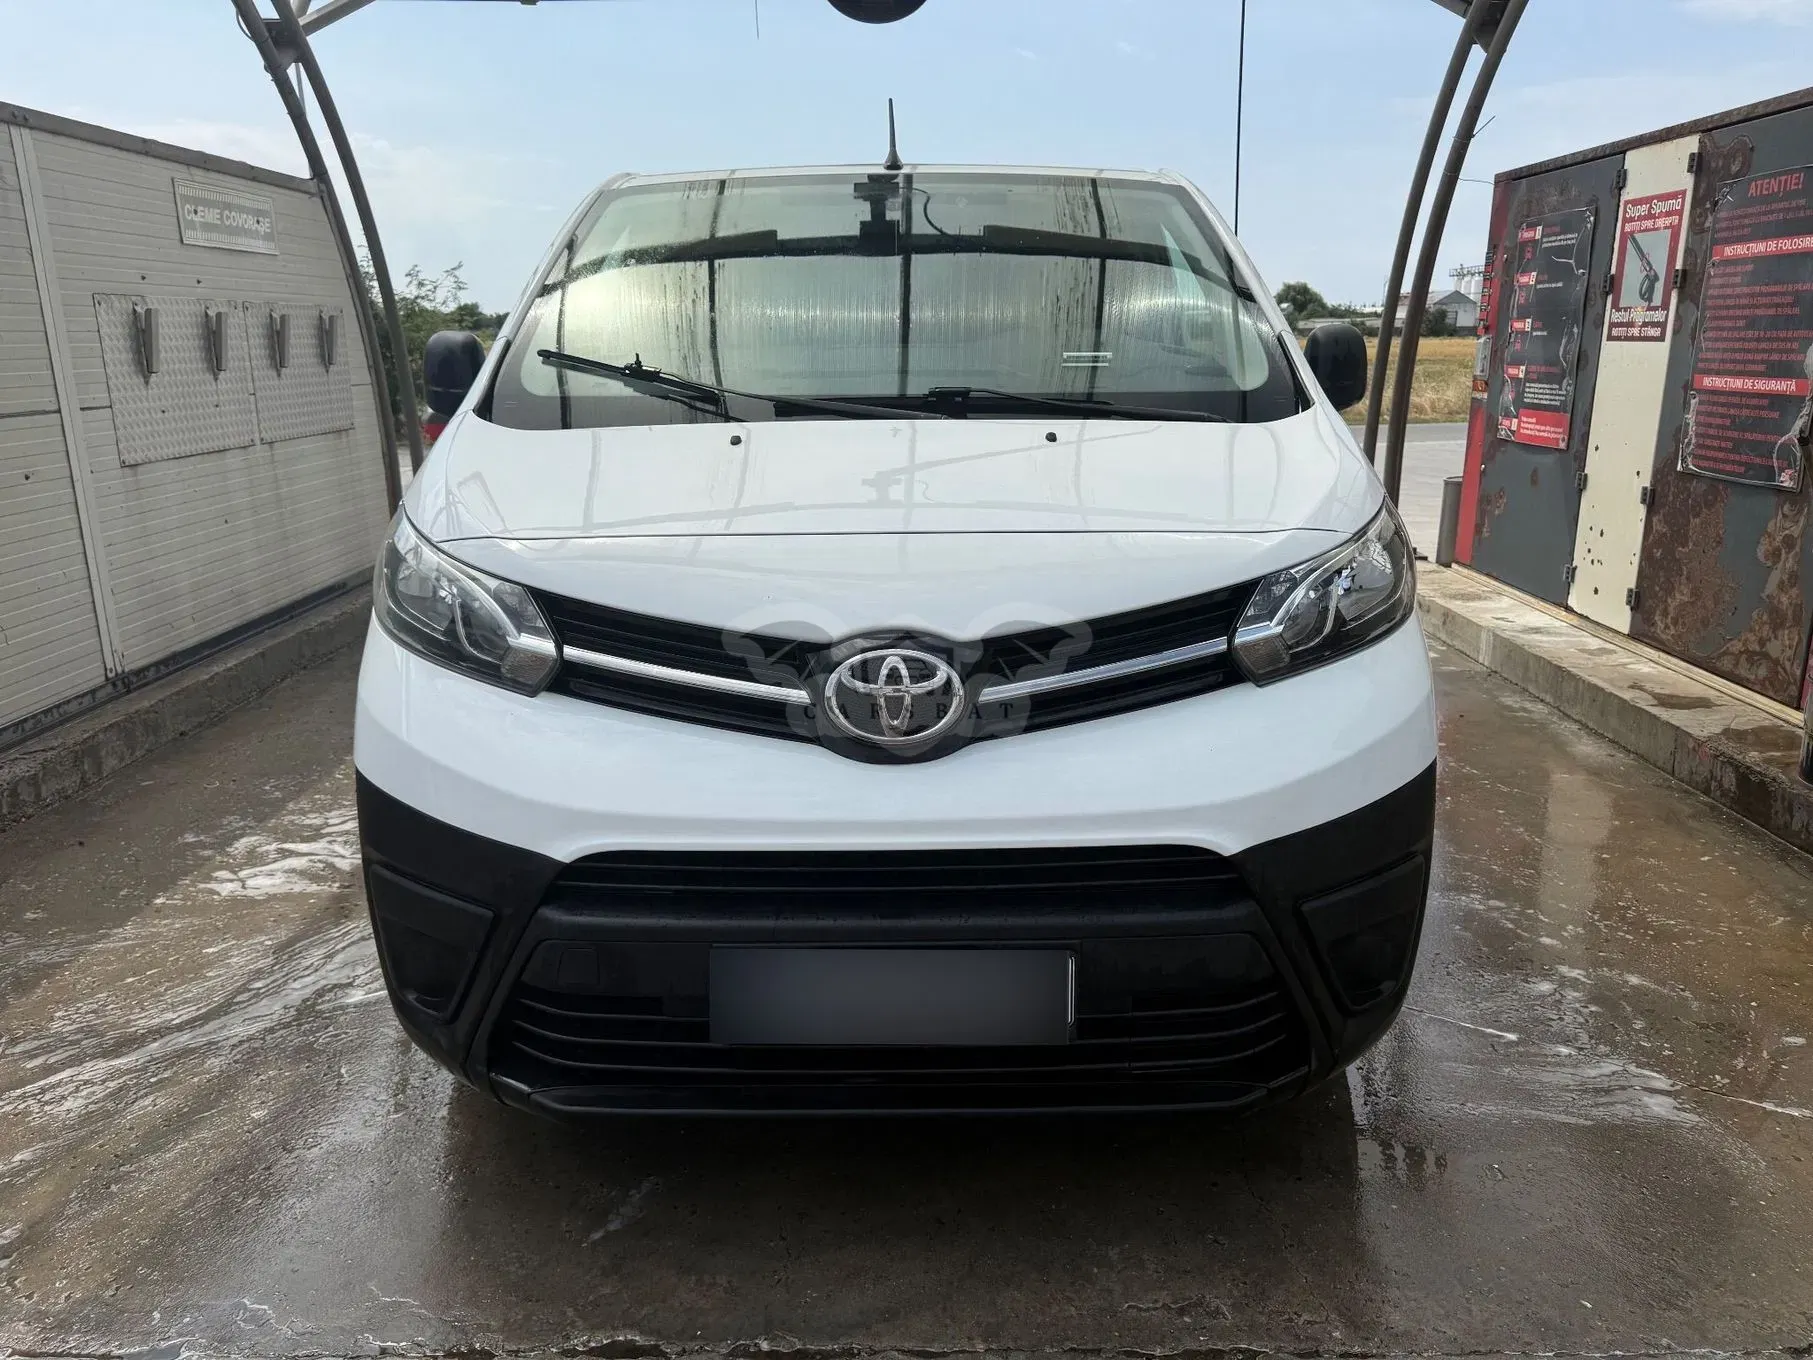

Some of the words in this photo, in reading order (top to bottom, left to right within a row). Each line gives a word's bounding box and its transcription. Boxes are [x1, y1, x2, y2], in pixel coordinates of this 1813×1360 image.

[1748, 173, 1804, 197] ATENȚIE!
[184, 204, 221, 224] CLEME
[1625, 203, 1650, 220] Super
[1651, 195, 1682, 216] Spumă
[1724, 241, 1766, 256] INSTRUCȚIUNI
[1767, 241, 1777, 252] DE
[1778, 237, 1813, 250] FOLOSIRE
[1703, 377, 1743, 390] INSTRUCȚIUNI
[1744, 379, 1753, 389] DE
[1754, 379, 1796, 394] SIGURANȚĂ
